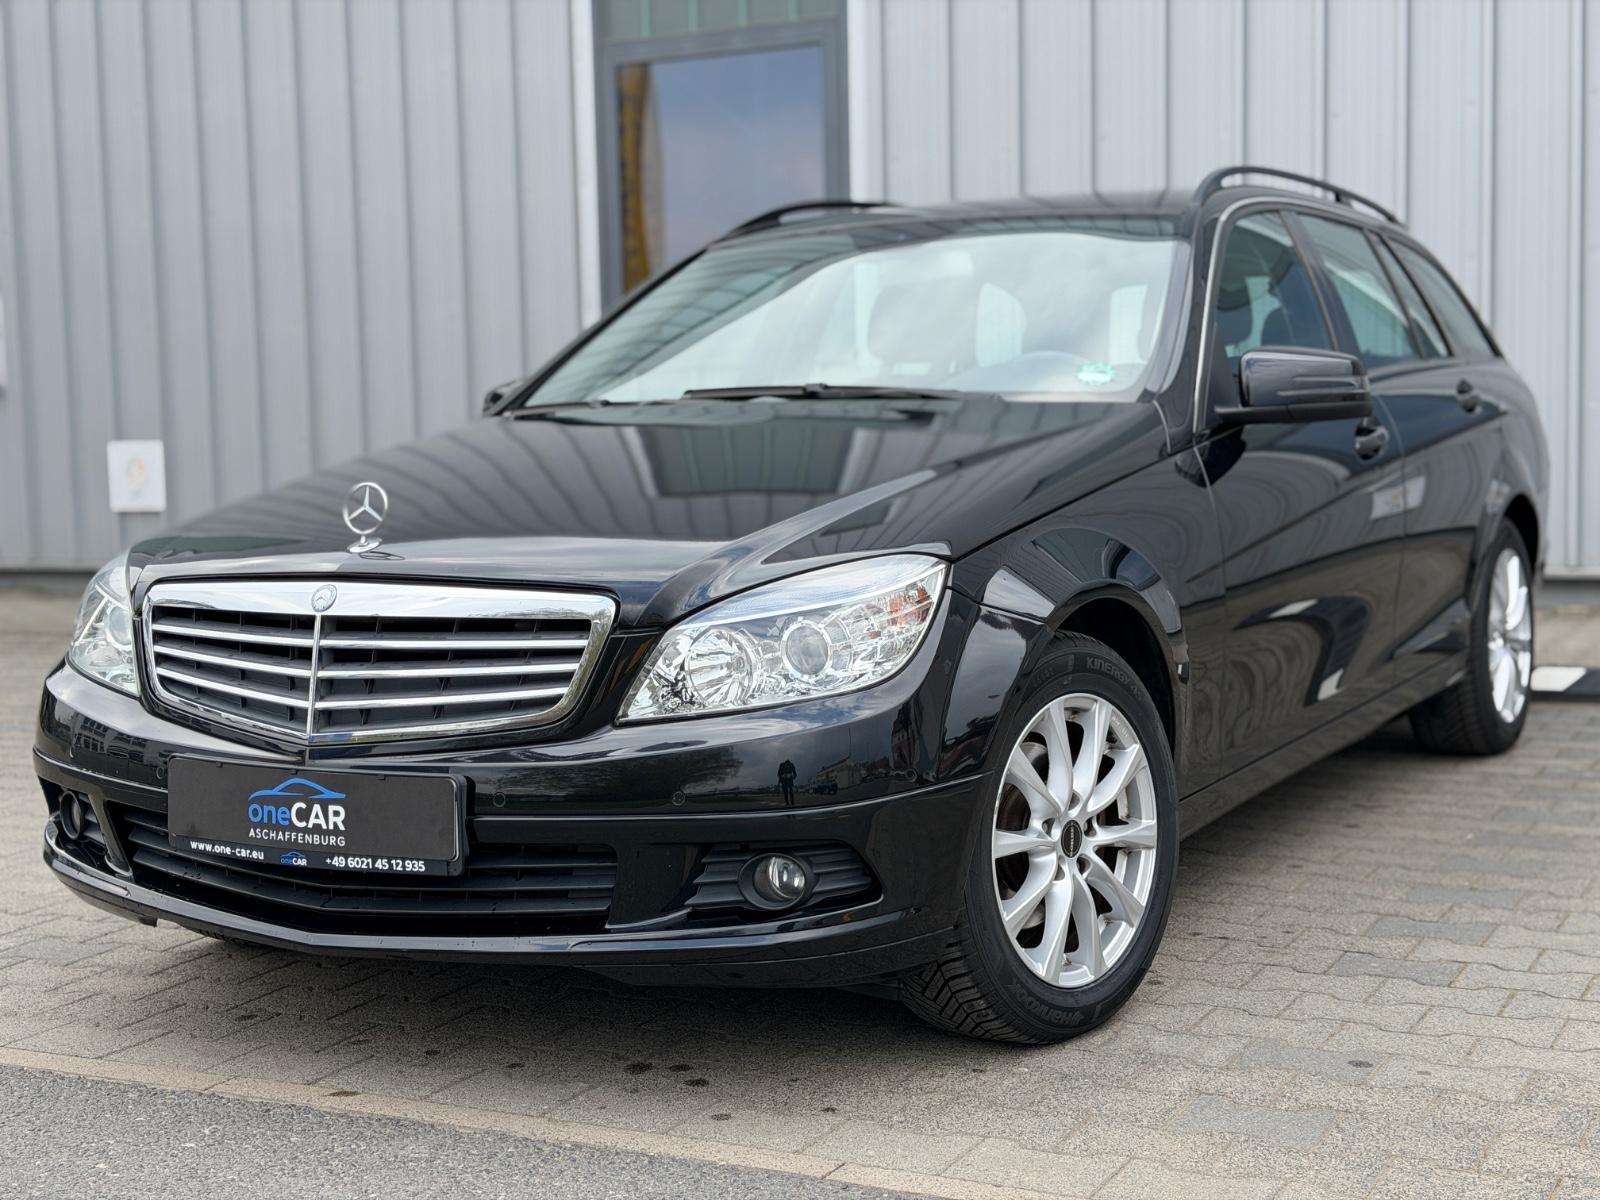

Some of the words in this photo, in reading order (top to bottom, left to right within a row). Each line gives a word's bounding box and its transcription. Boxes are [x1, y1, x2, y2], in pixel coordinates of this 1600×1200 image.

[248, 801, 346, 831] oneCAR
[249, 827, 346, 847] ASCHAFFENBURG
[190, 841, 264, 860] www.one-car.eu
[325, 856, 346, 867] +49
[347, 857, 373, 869] 6021
[375, 859, 389, 870] 45
[391, 859, 403, 871] 12
[405, 860, 426, 872] 935
